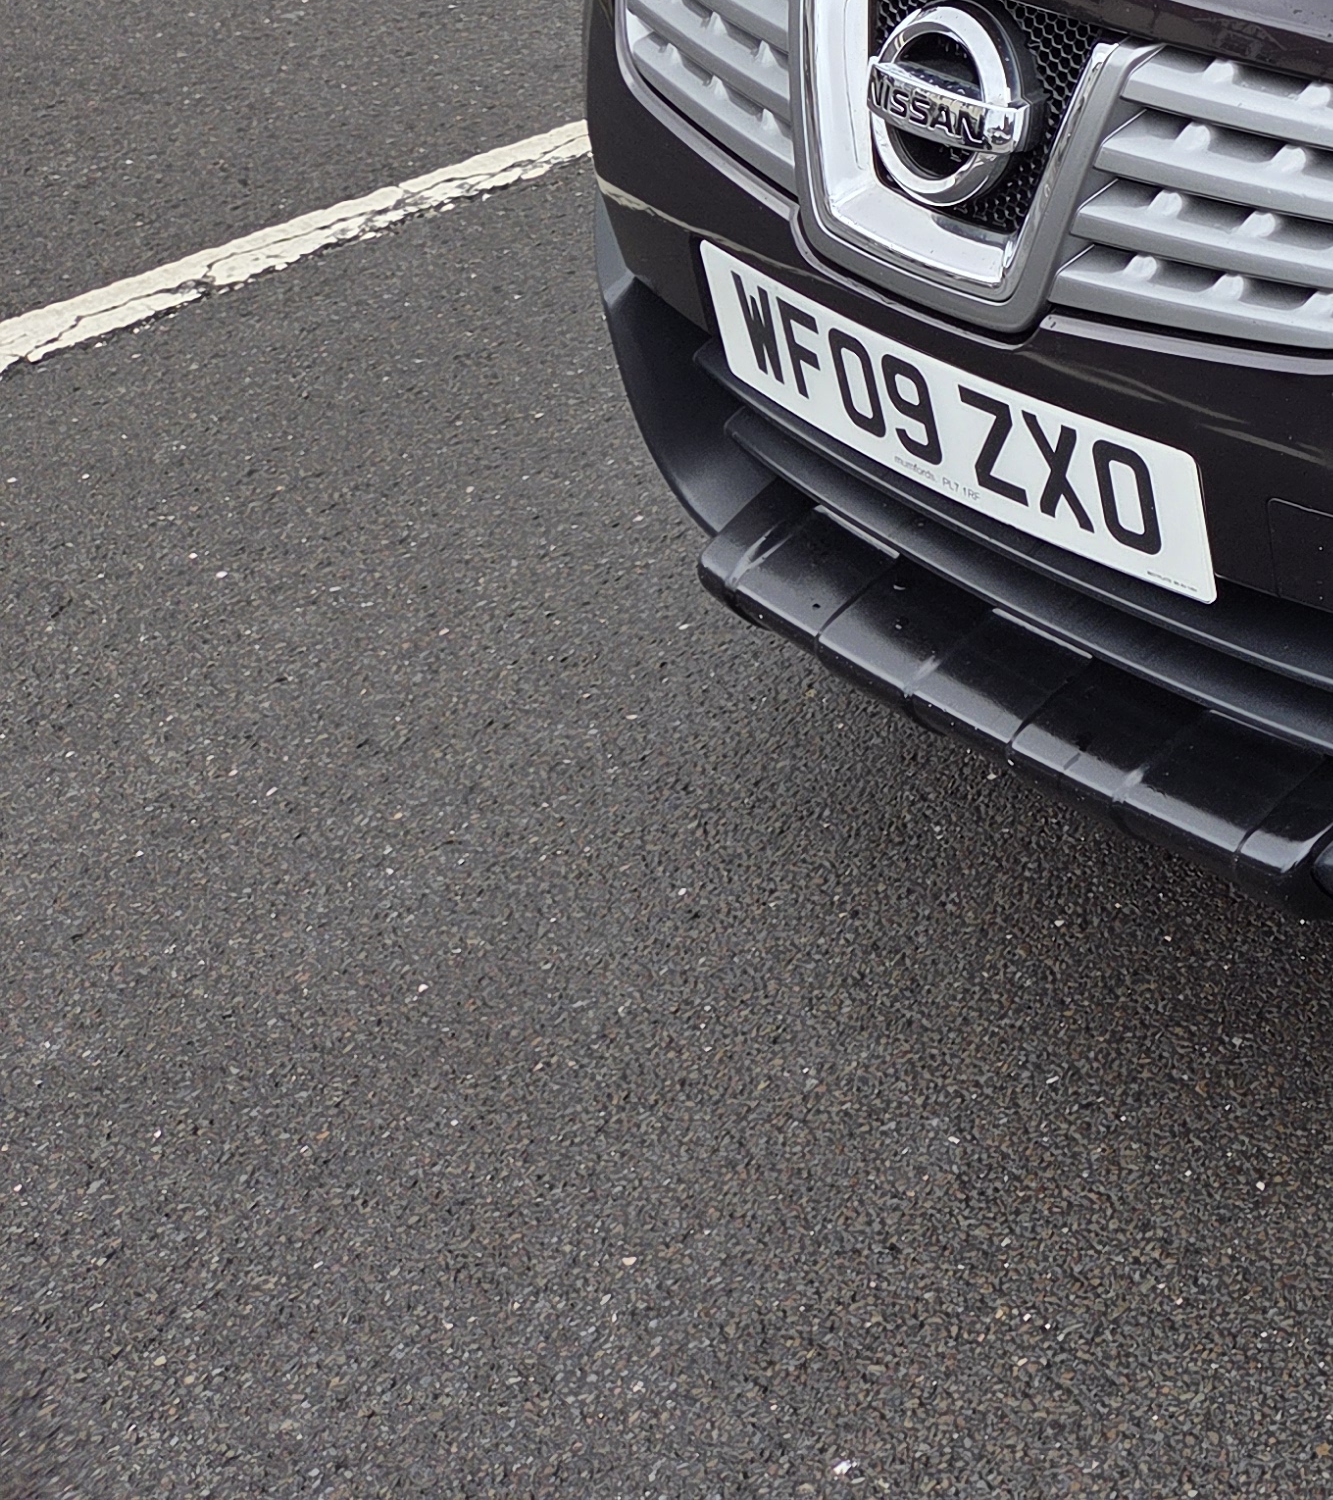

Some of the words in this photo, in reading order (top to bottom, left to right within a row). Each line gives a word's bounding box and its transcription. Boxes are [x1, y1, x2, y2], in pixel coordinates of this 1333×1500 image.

[868, 71, 987, 149] NISSAN
[731, 270, 943, 466] WF09
[957, 384, 1162, 556] ZXO
